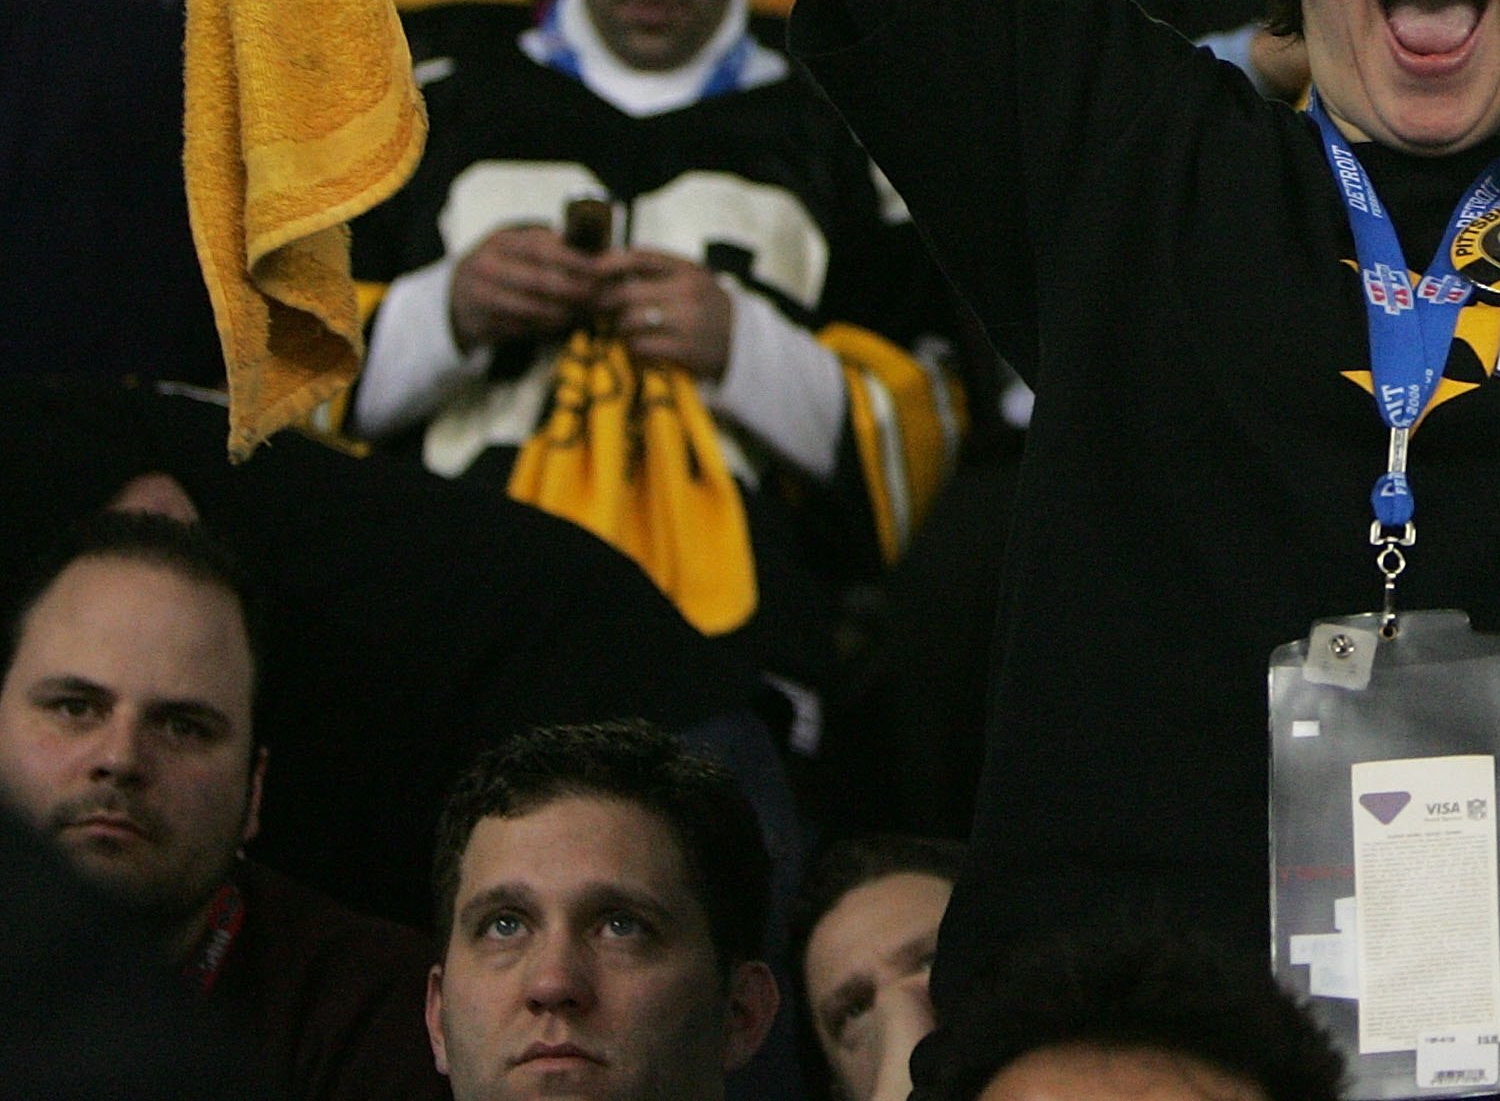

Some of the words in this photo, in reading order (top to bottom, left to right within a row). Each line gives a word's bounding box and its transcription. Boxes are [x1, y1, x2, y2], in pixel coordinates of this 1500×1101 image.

[1332, 145, 1368, 213] DETROIT
[1405, 384, 1420, 415] 2006
[1425, 801, 1461, 815] VISA
